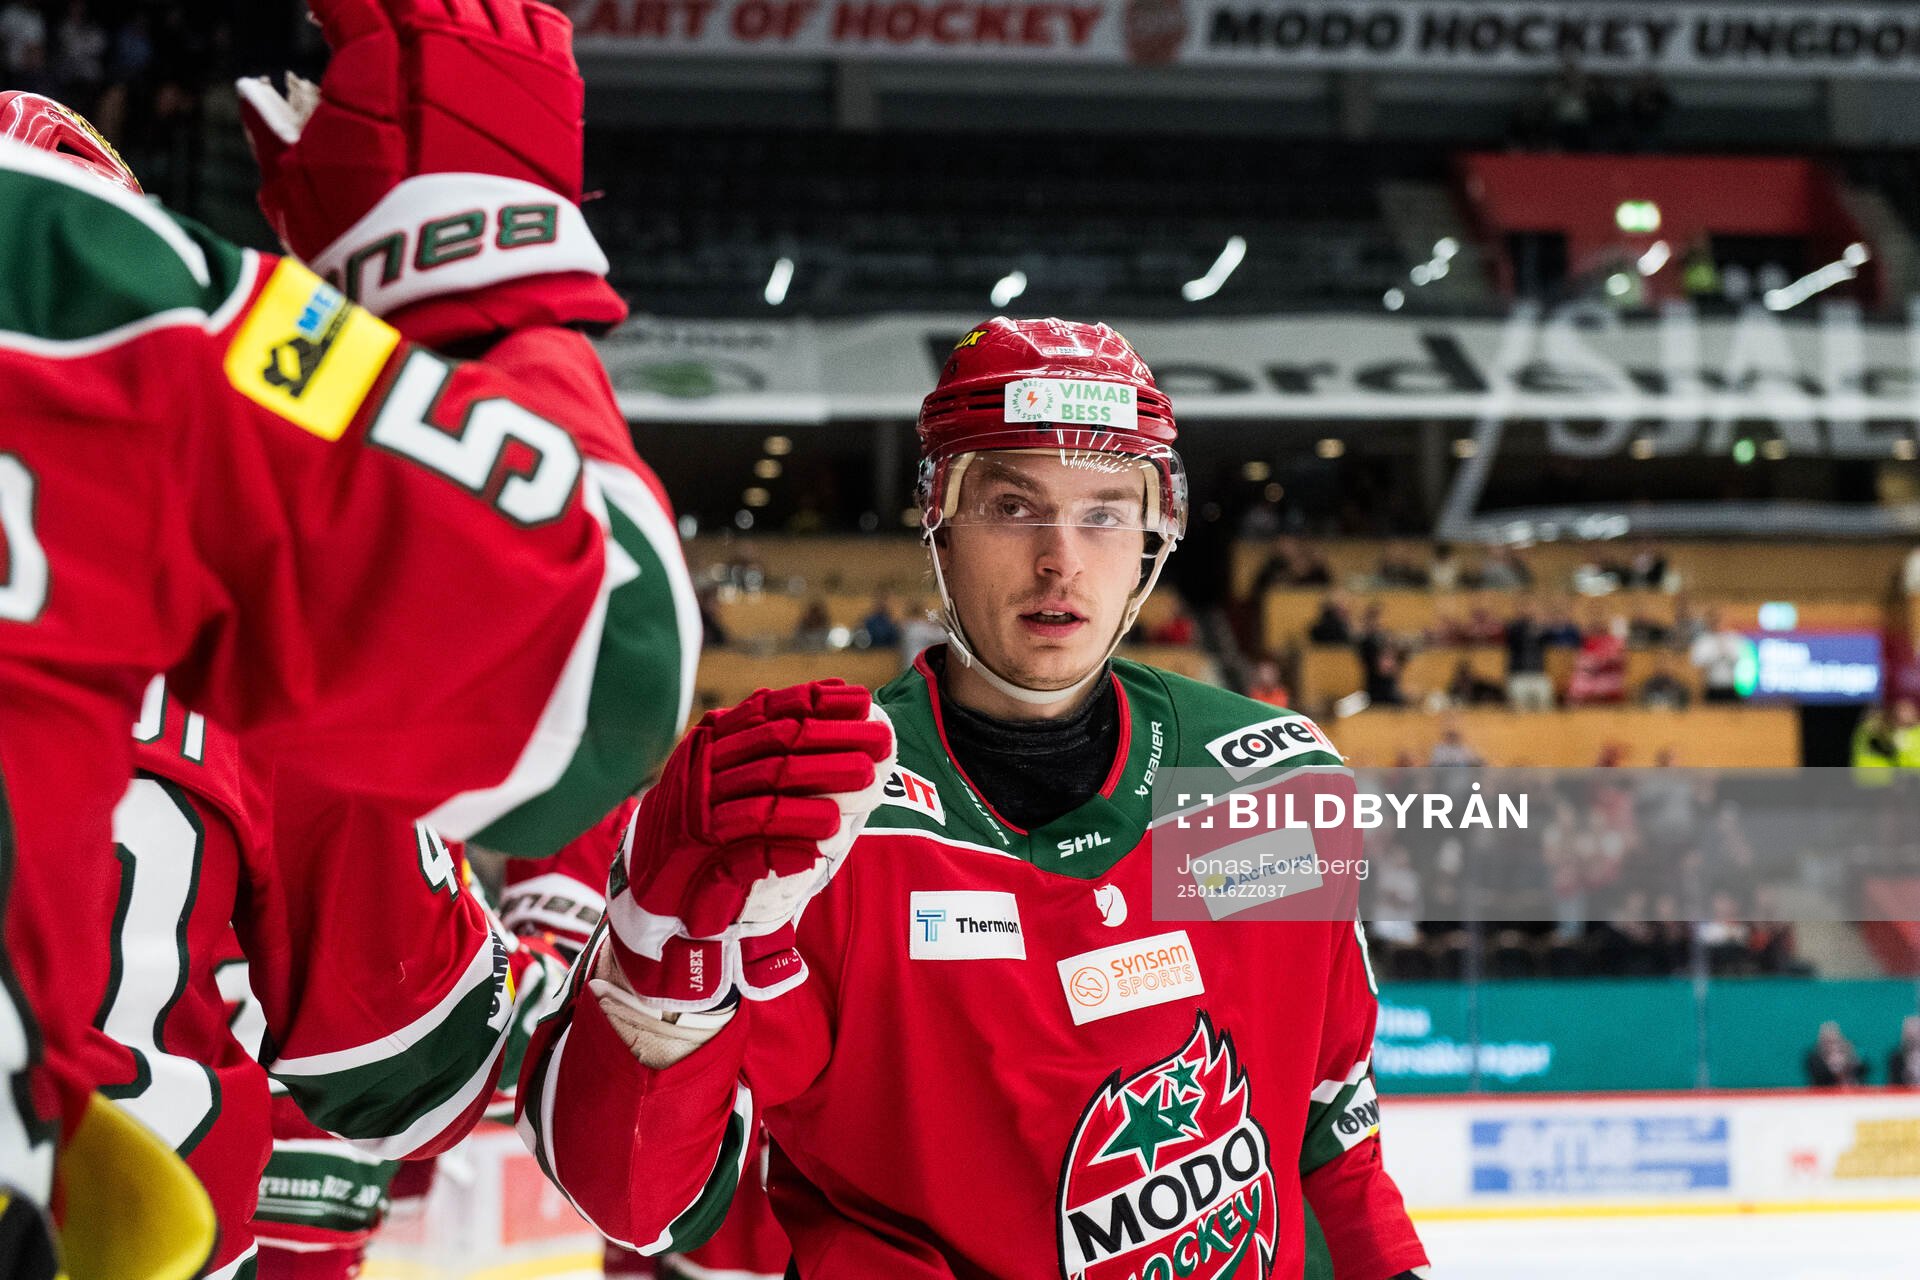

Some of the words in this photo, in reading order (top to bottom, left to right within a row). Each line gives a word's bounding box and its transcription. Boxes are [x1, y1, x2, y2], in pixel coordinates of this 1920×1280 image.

[573, 0, 711, 38] ART
[730, 0, 806, 41] OF
[829, 0, 1100, 46] HOCKEY
[1207, 9, 1400, 53] MODO
[1420, 12, 1678, 58] HOCKEY
[1694, 16, 1920, 59] UNGDO
[1059, 383, 1131, 405] VIMAB
[1061, 404, 1112, 422] BESS
[367, 344, 583, 527] 5
[1057, 831, 1111, 859] SHL
[956, 917, 1019, 934] Thermion
[689, 949, 704, 992] JASEK
[1110, 945, 1190, 978] SYNSAM
[1117, 964, 1194, 997] SPORTS
[1068, 1128, 1260, 1263] MODO
[1127, 1180, 1262, 1280] OCKEY
